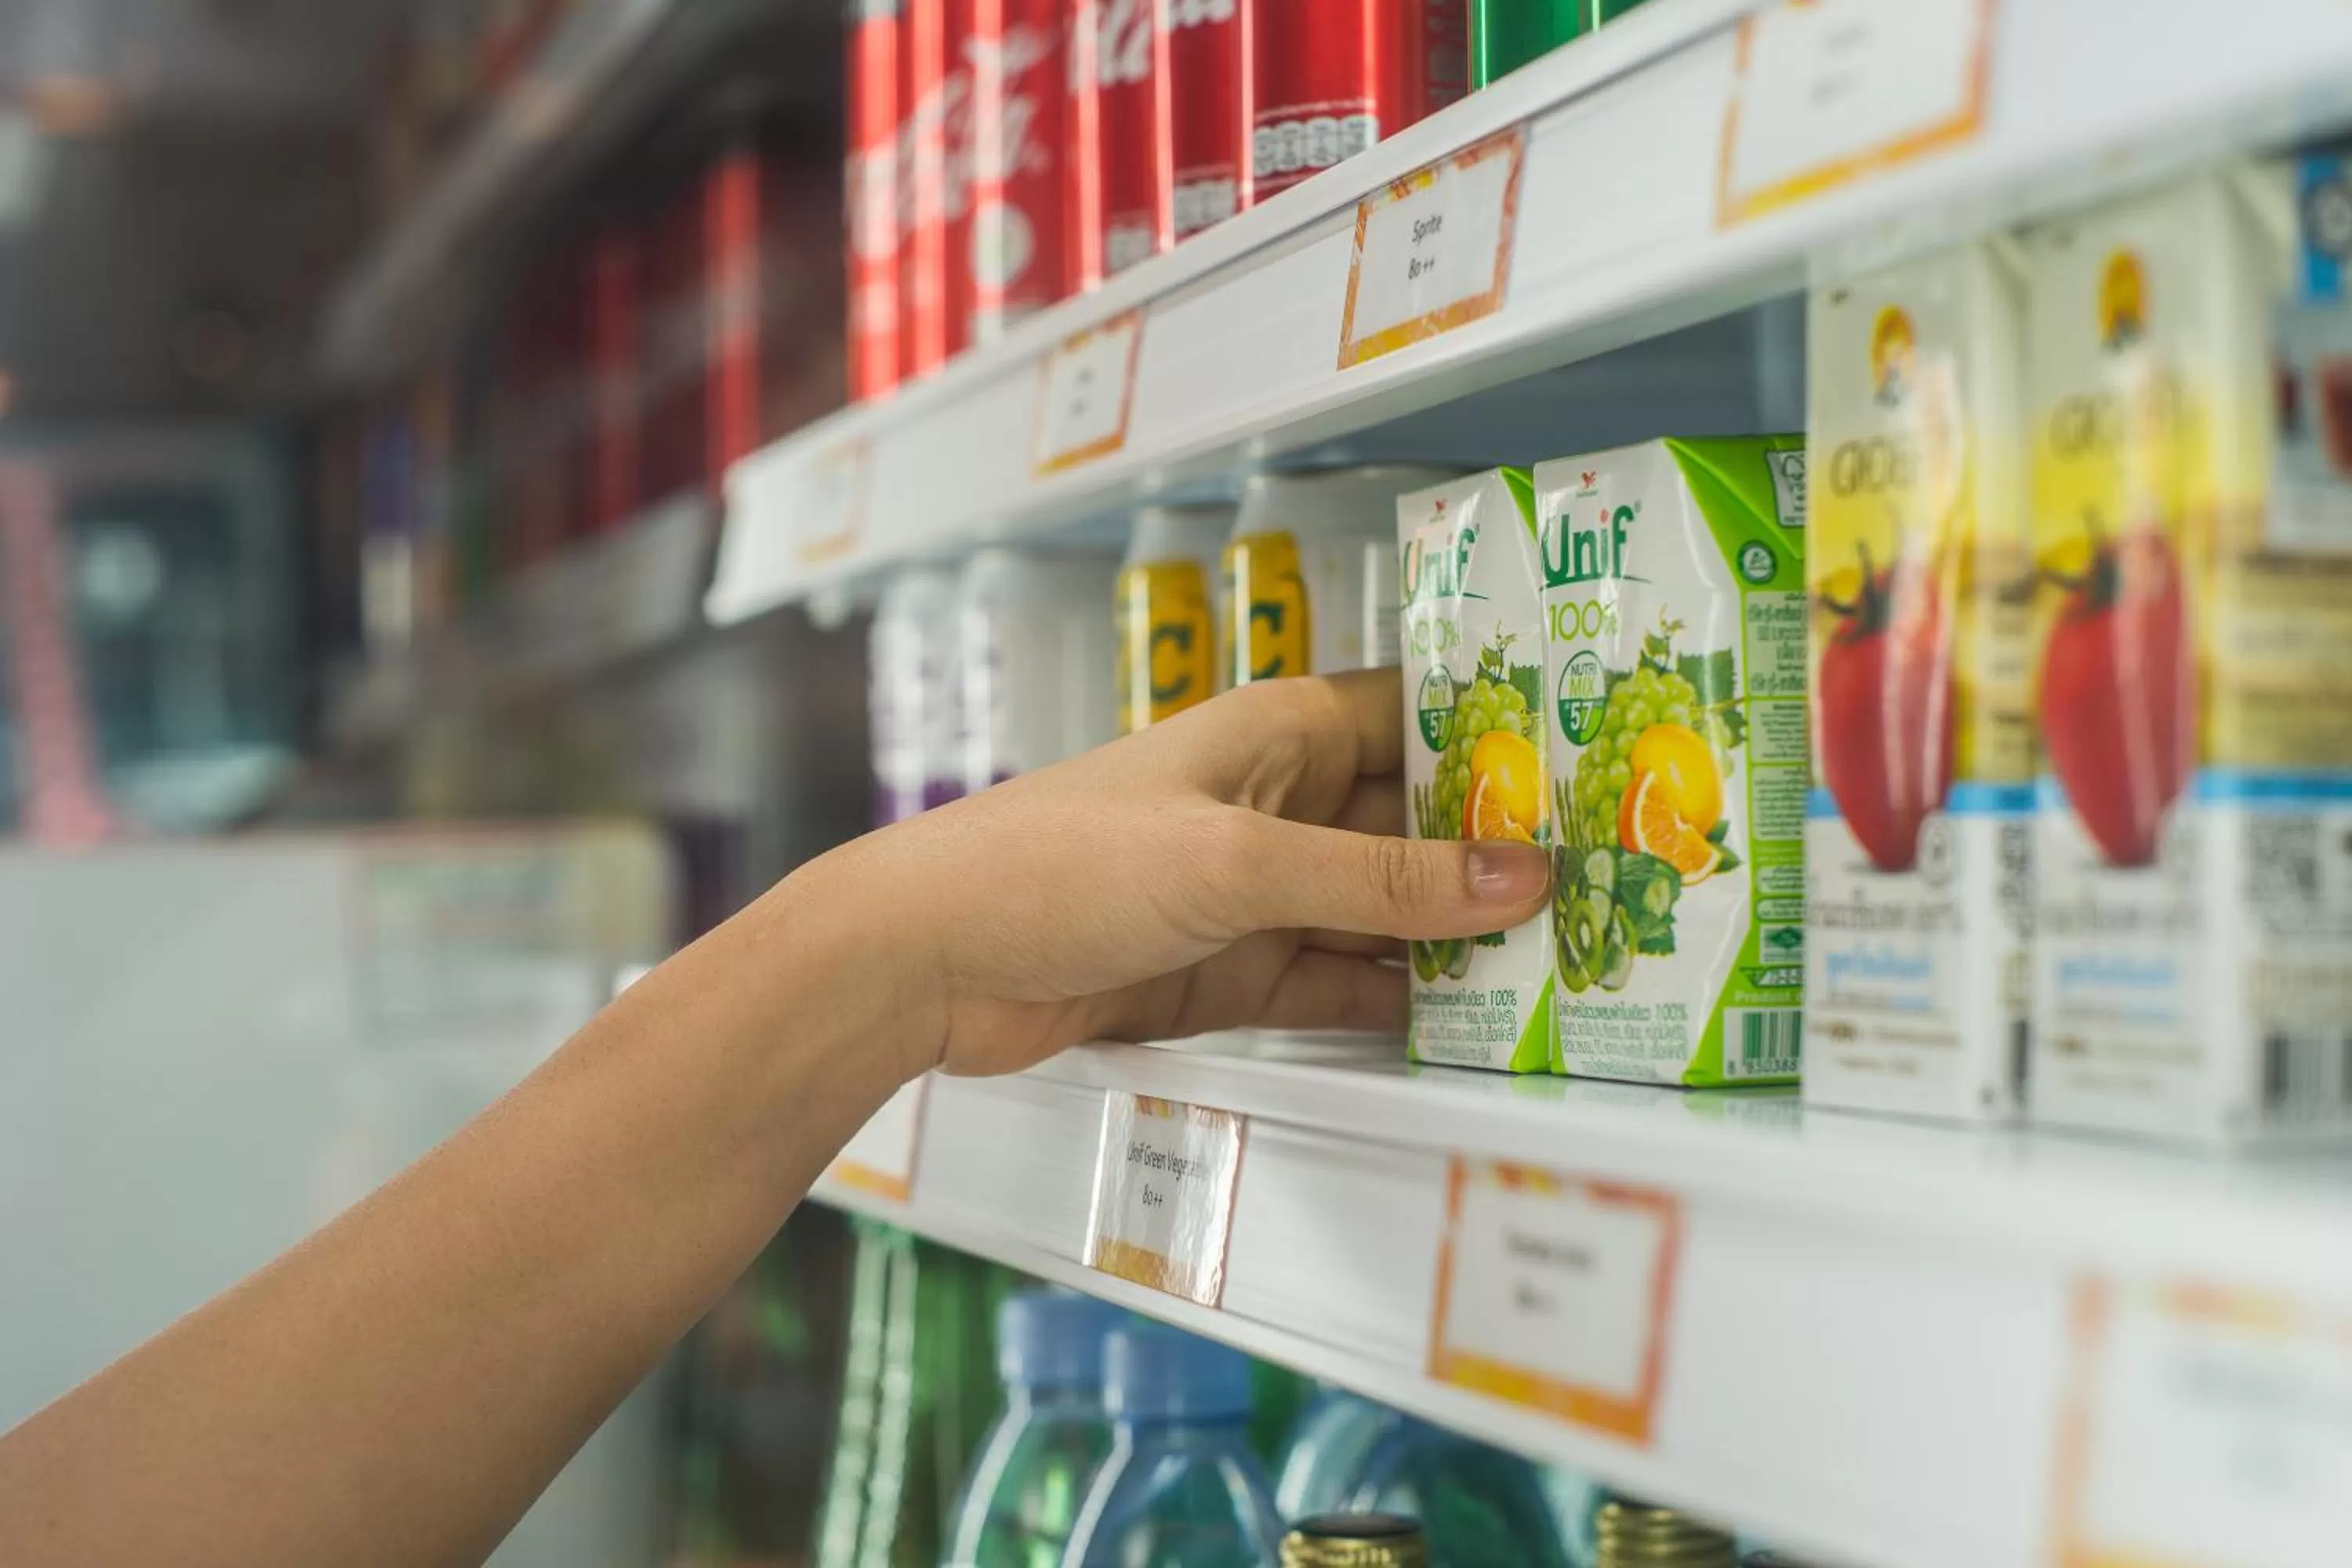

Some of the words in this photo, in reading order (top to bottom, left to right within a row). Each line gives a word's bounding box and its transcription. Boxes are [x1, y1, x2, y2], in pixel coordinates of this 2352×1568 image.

[1412, 214, 1443, 246] Sprite
[1541, 505, 1635, 586] Unif
[1403, 527, 1475, 604] Unif
[1548, 599, 1618, 642] 100%
[1570, 663, 1598, 677] NUTRI
[1569, 677, 1595, 698] MIX
[1429, 710, 1446, 738] 57
[1569, 701, 1594, 731] 57
[1490, 989, 1517, 1007] 100%
[1144, 1145, 1167, 1170] Green
